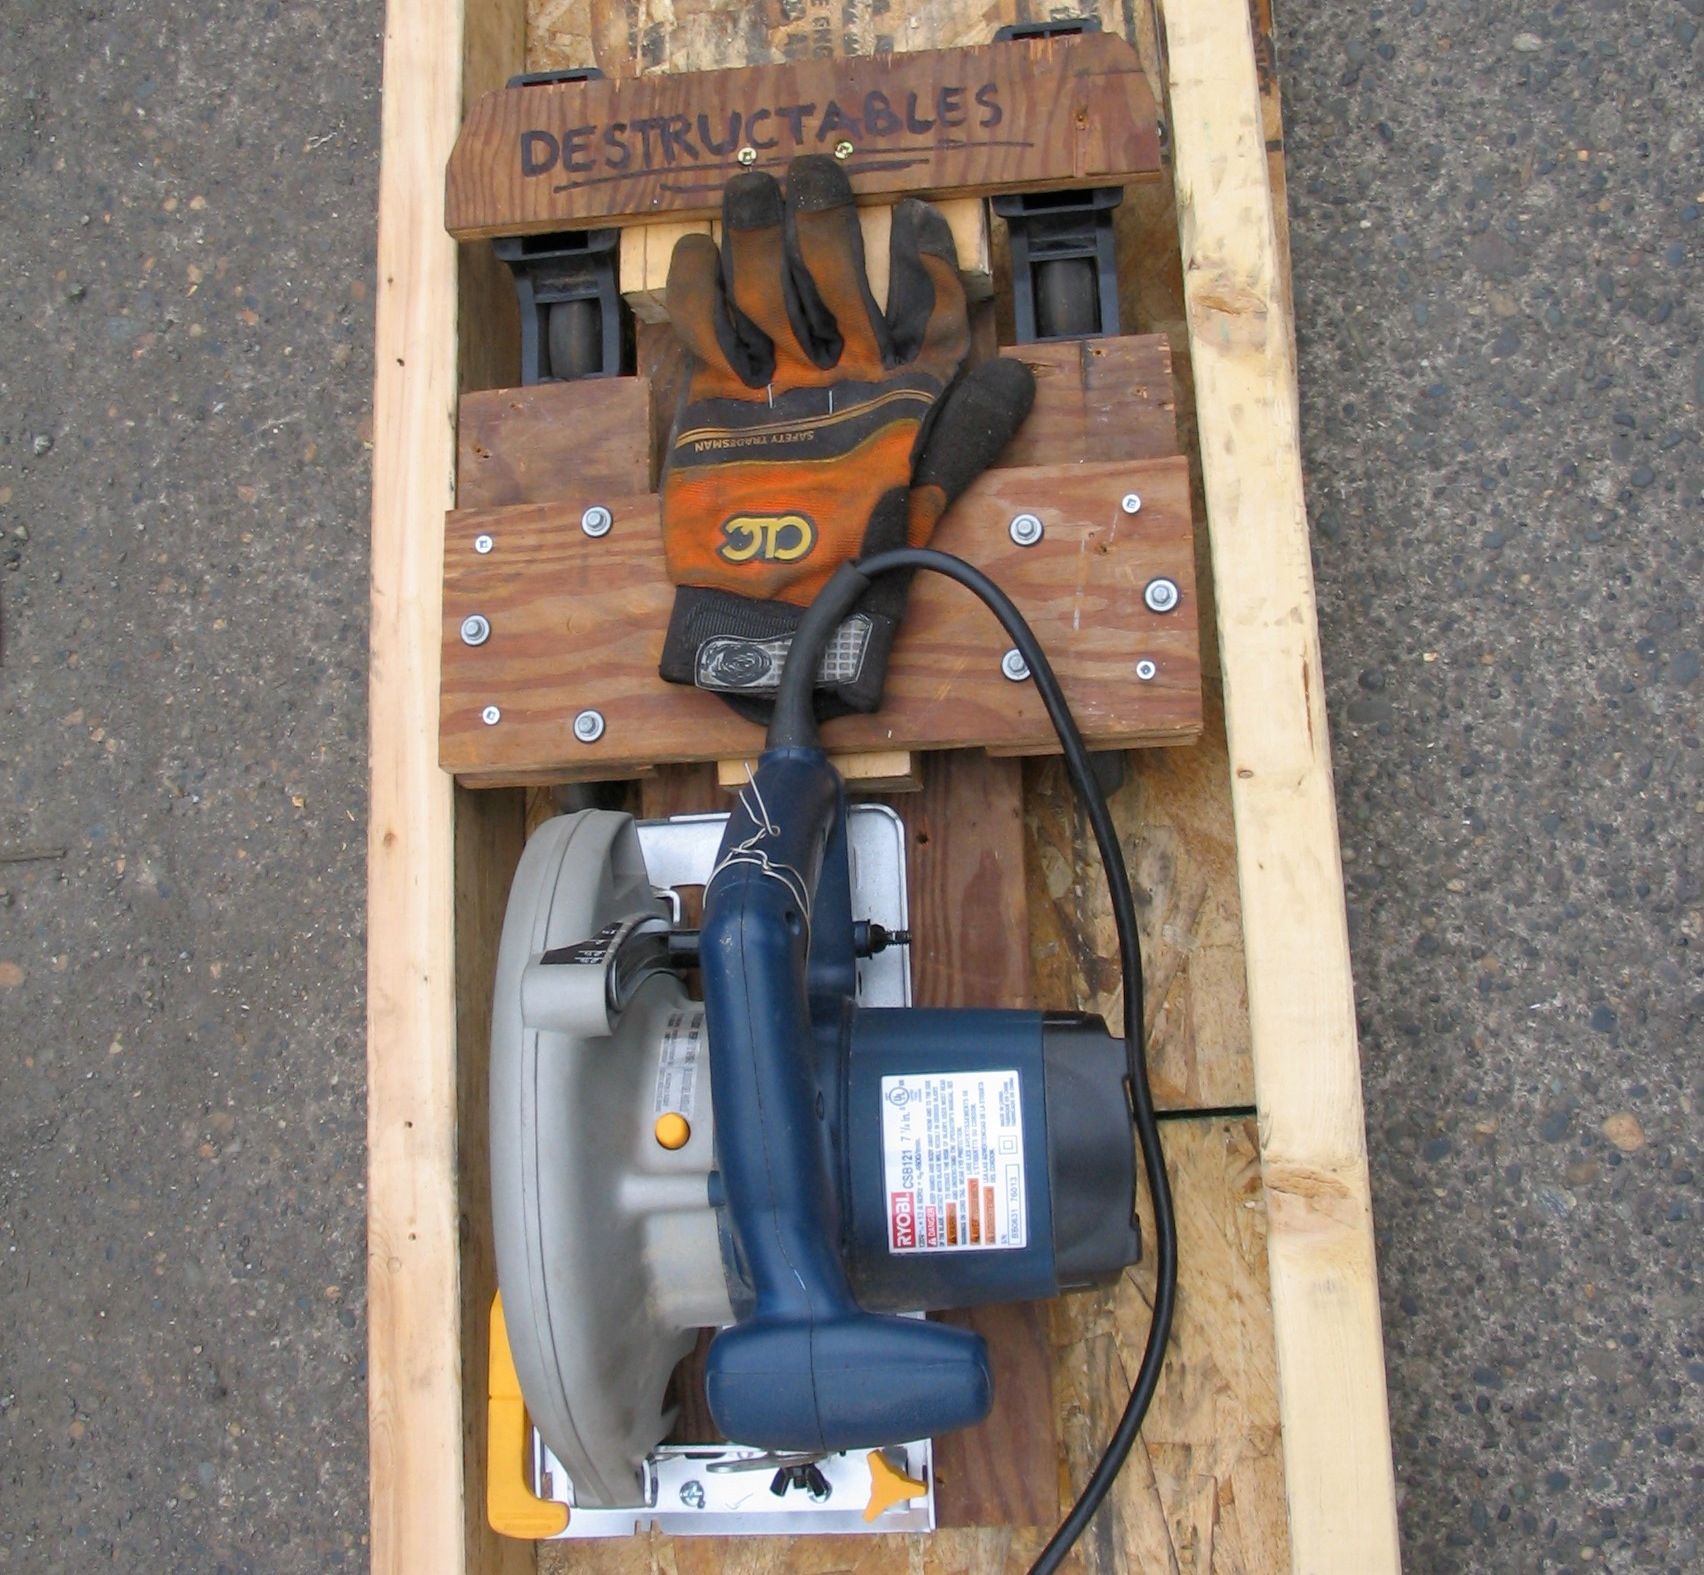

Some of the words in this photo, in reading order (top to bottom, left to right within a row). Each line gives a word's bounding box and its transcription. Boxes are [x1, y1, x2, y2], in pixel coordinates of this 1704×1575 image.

[520, 83, 1003, 178] DESTRUCTABLES
[694, 436, 768, 452] TRADESMAN
[771, 430, 814, 444] SAFETY
[721, 515, 812, 561] CLC
[901, 1150, 914, 1189] CSB121
[895, 1197, 911, 1246] RYOBI
